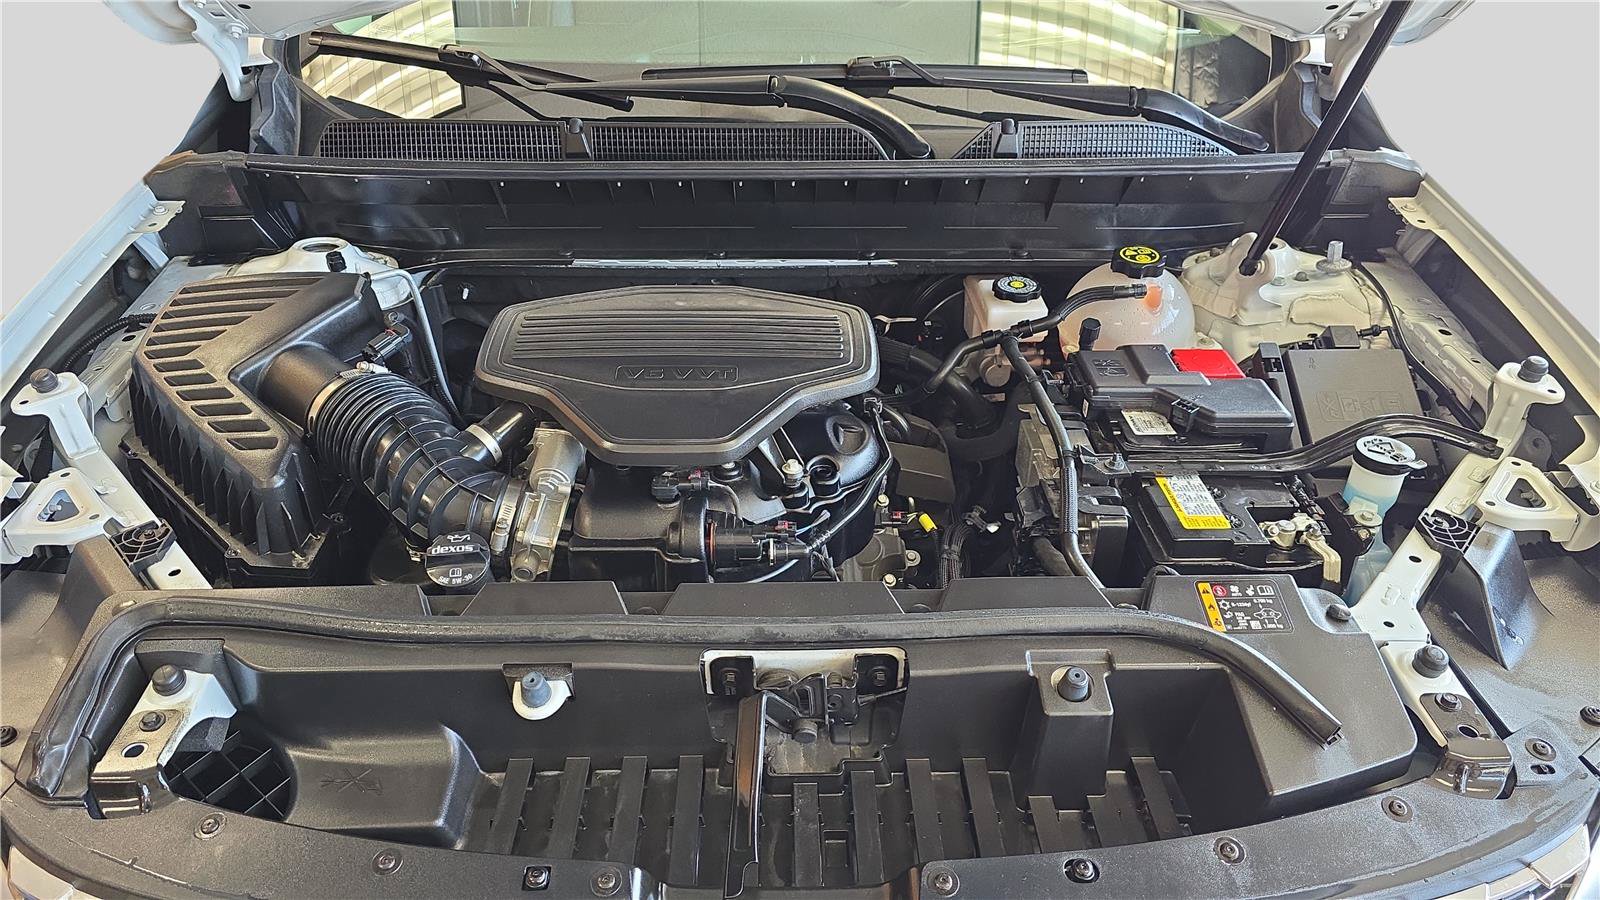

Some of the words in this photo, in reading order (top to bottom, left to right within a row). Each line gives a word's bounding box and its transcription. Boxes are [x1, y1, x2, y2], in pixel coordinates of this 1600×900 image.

[623, 368, 664, 379] V6
[671, 368, 734, 379] VVT
[431, 545, 474, 554] dexos
